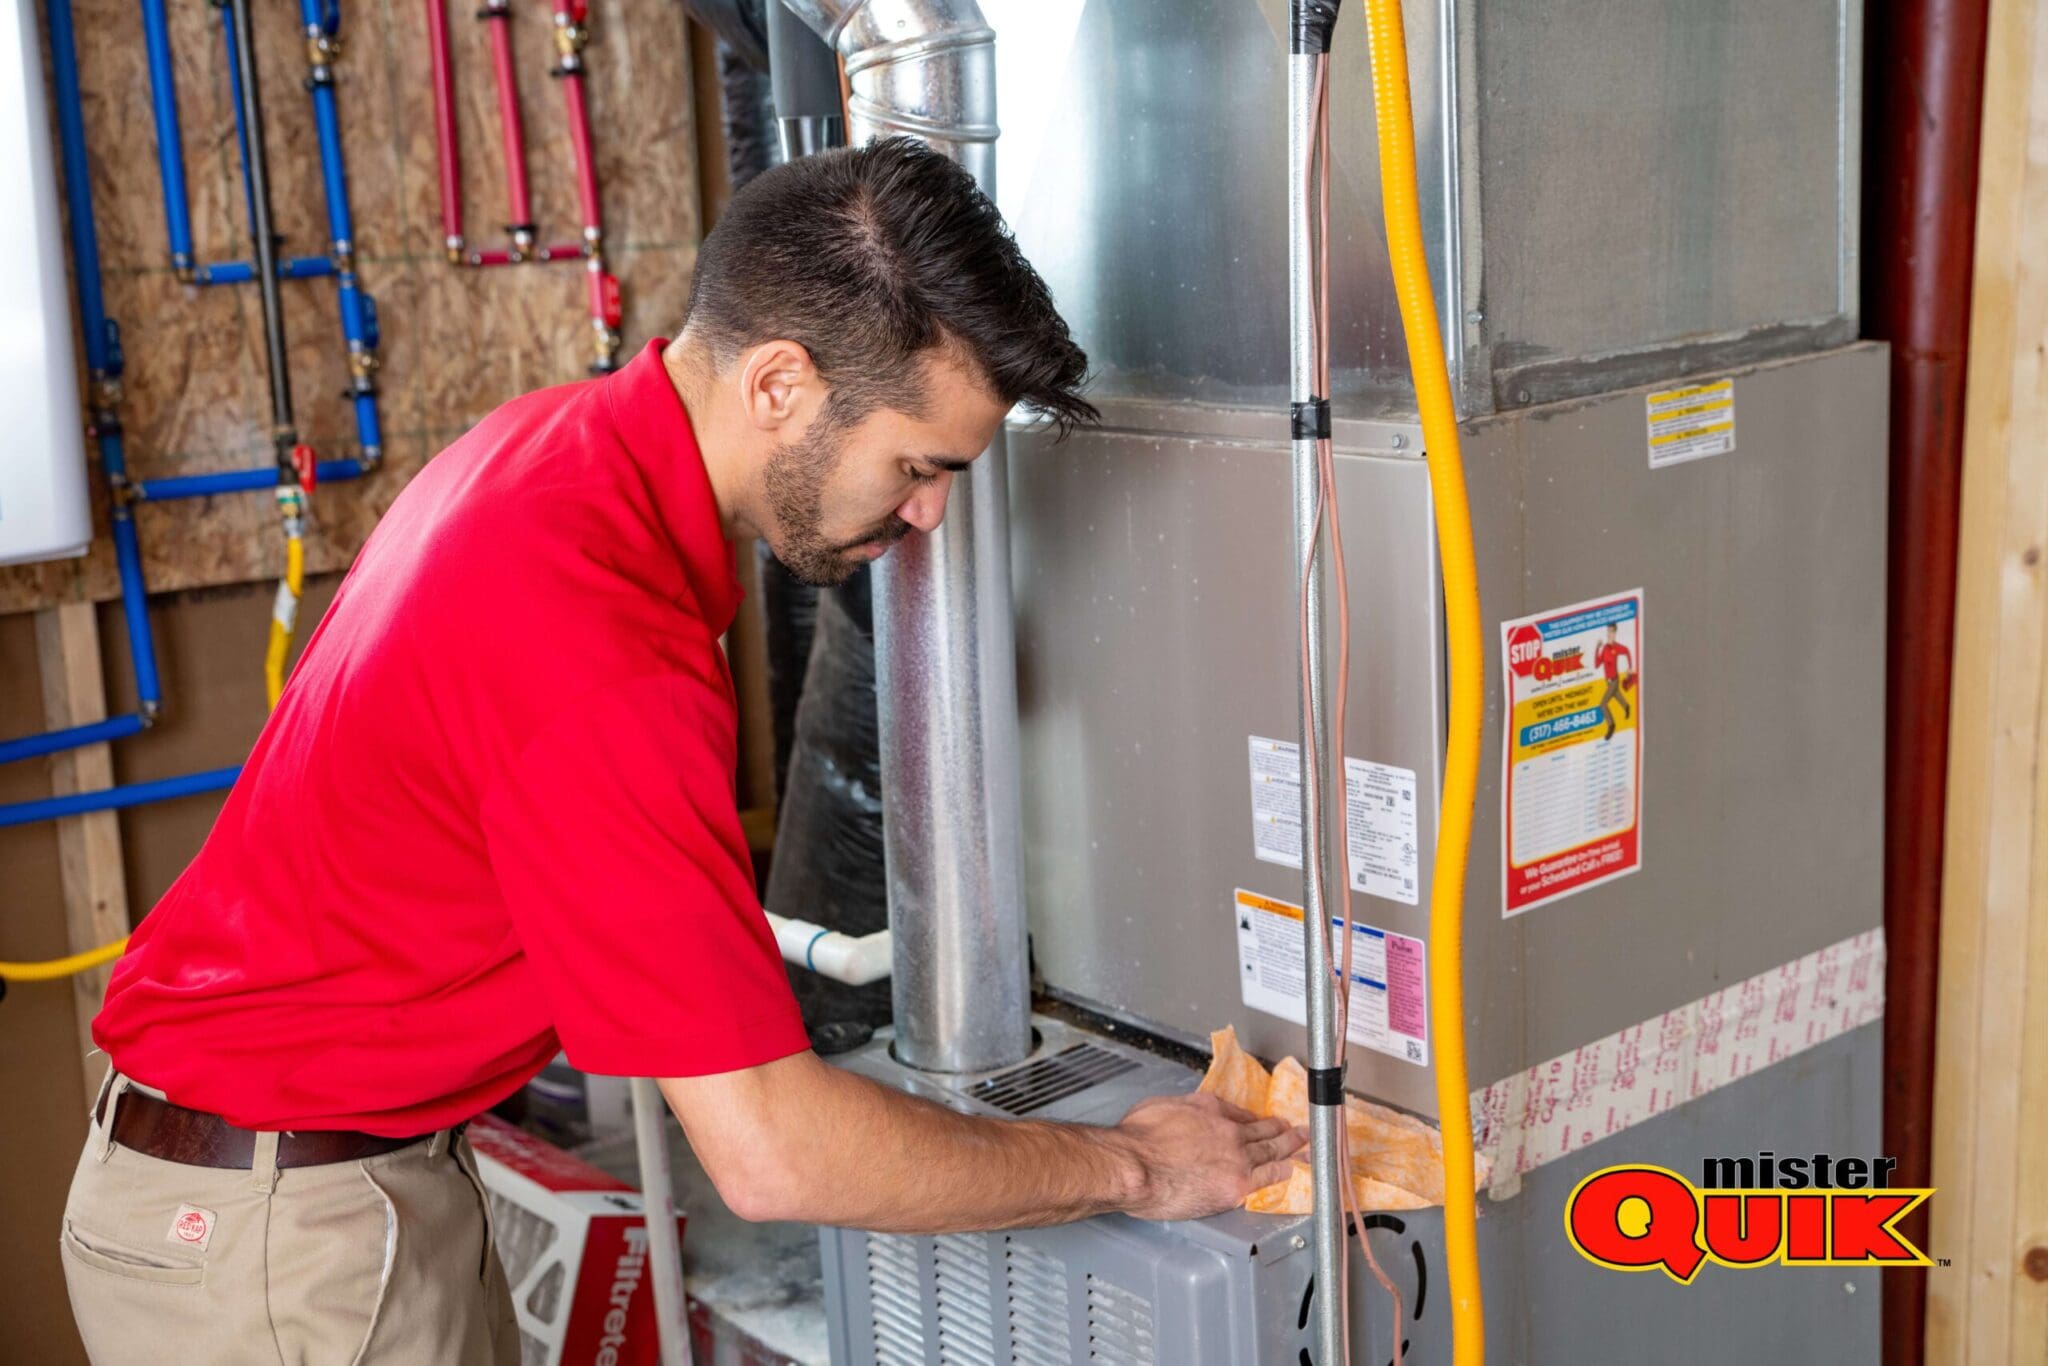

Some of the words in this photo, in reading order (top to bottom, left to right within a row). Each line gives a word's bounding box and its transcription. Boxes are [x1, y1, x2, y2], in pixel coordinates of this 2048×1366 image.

[1511, 639, 1540, 664] STOP
[1552, 646, 1581, 659] mister
[1533, 653, 1584, 682] QUIK
[1529, 723, 1552, 743] (317)
[595, 1226, 650, 1366] Filtrete
